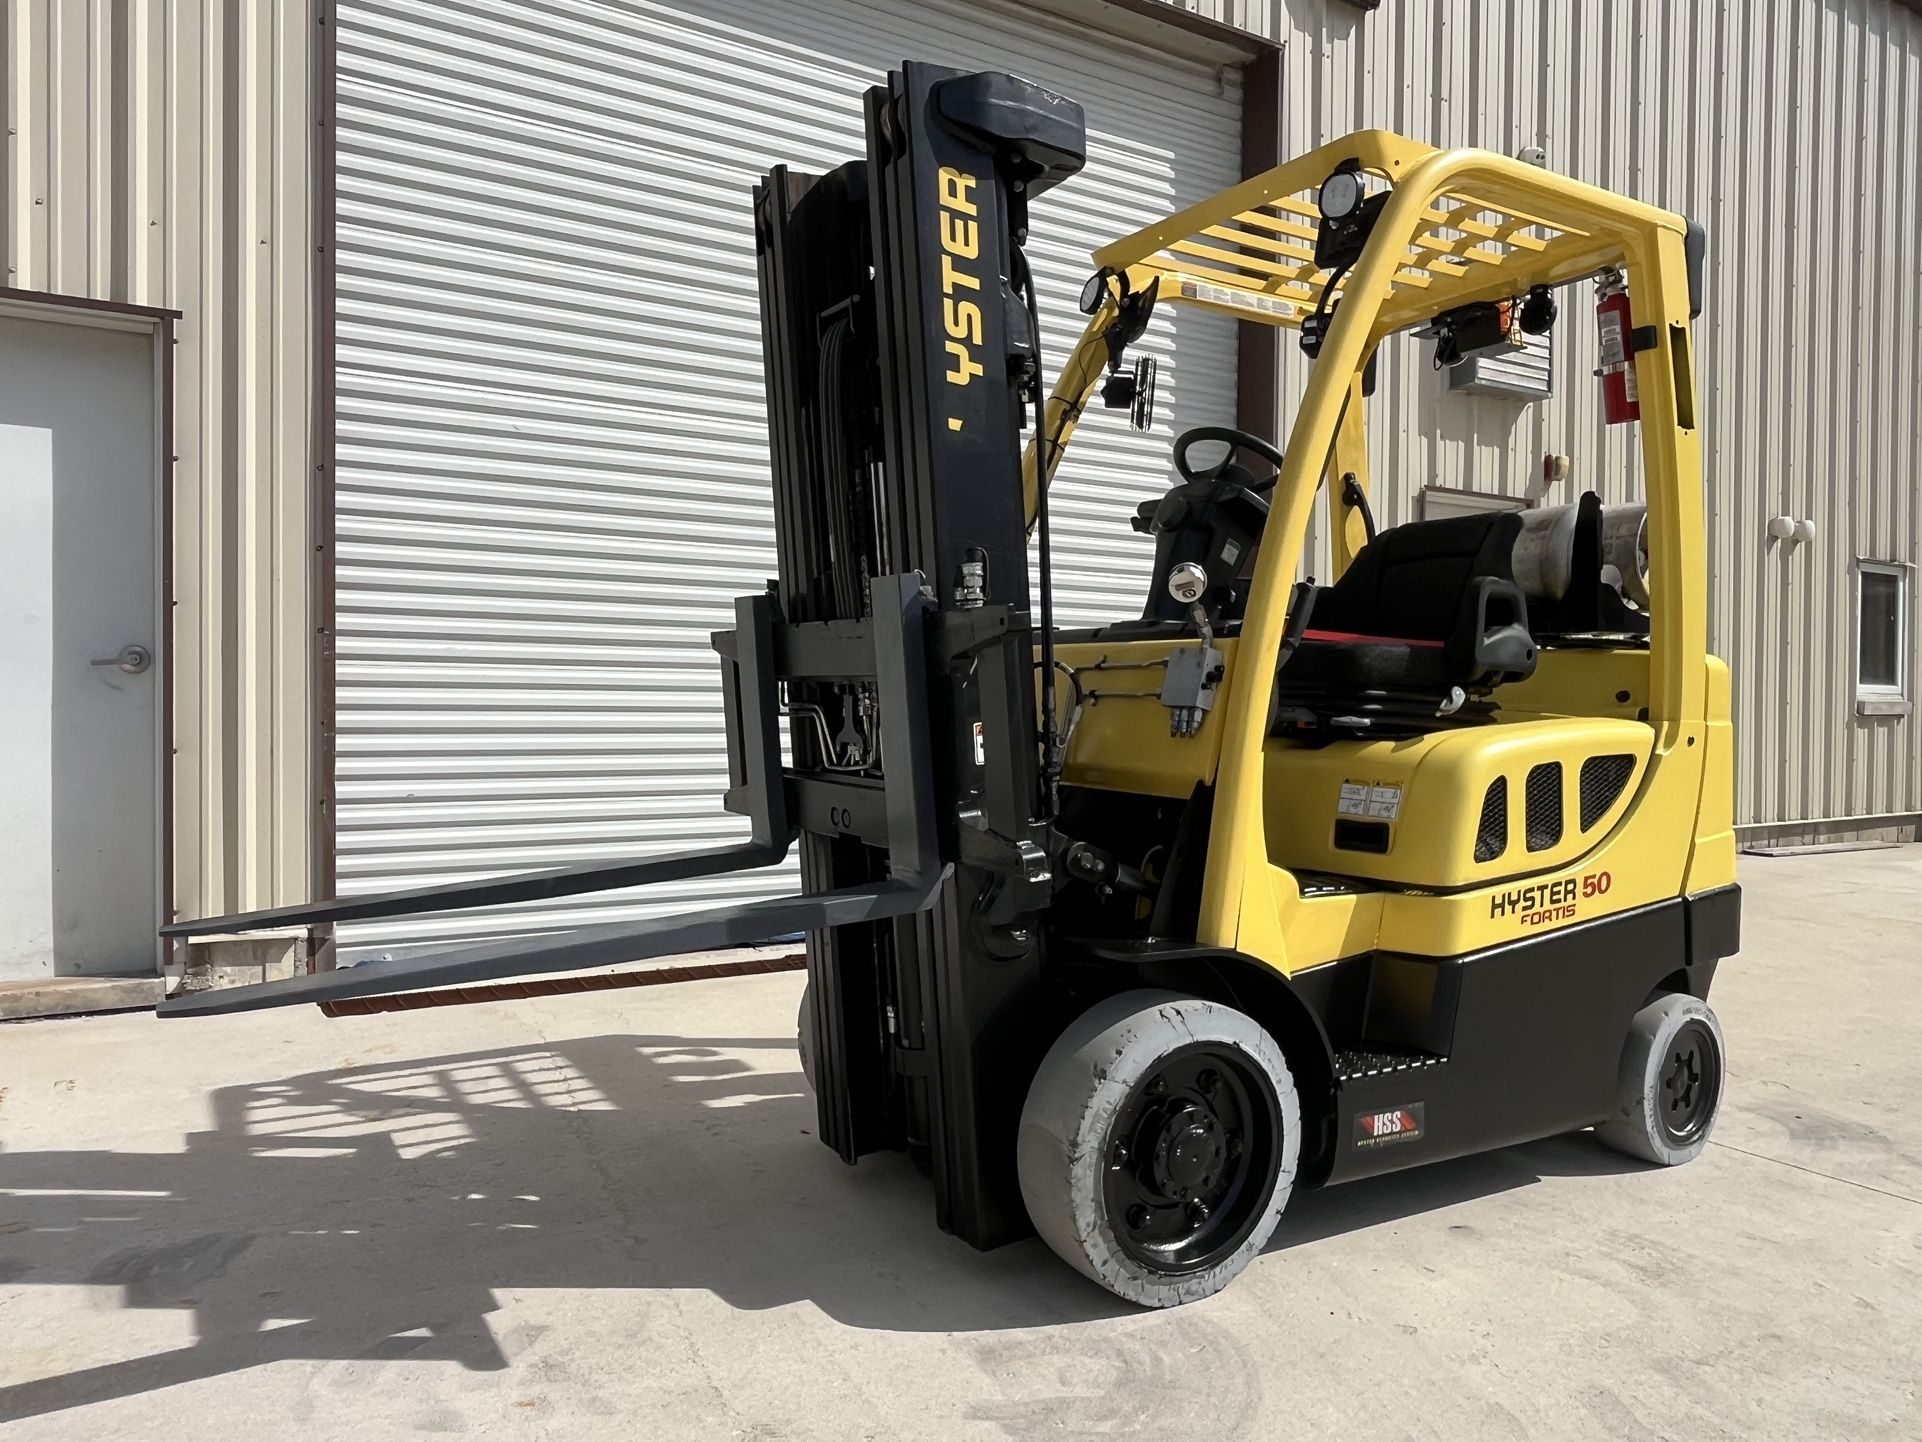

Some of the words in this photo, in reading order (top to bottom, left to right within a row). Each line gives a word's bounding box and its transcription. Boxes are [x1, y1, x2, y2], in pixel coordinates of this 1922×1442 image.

[938, 166, 984, 431] YSTER
[1490, 878, 1577, 919] HYSTER
[1582, 871, 1611, 898] 50
[1520, 903, 1577, 926] FORTIS
[1373, 1110, 1402, 1136] HSS
